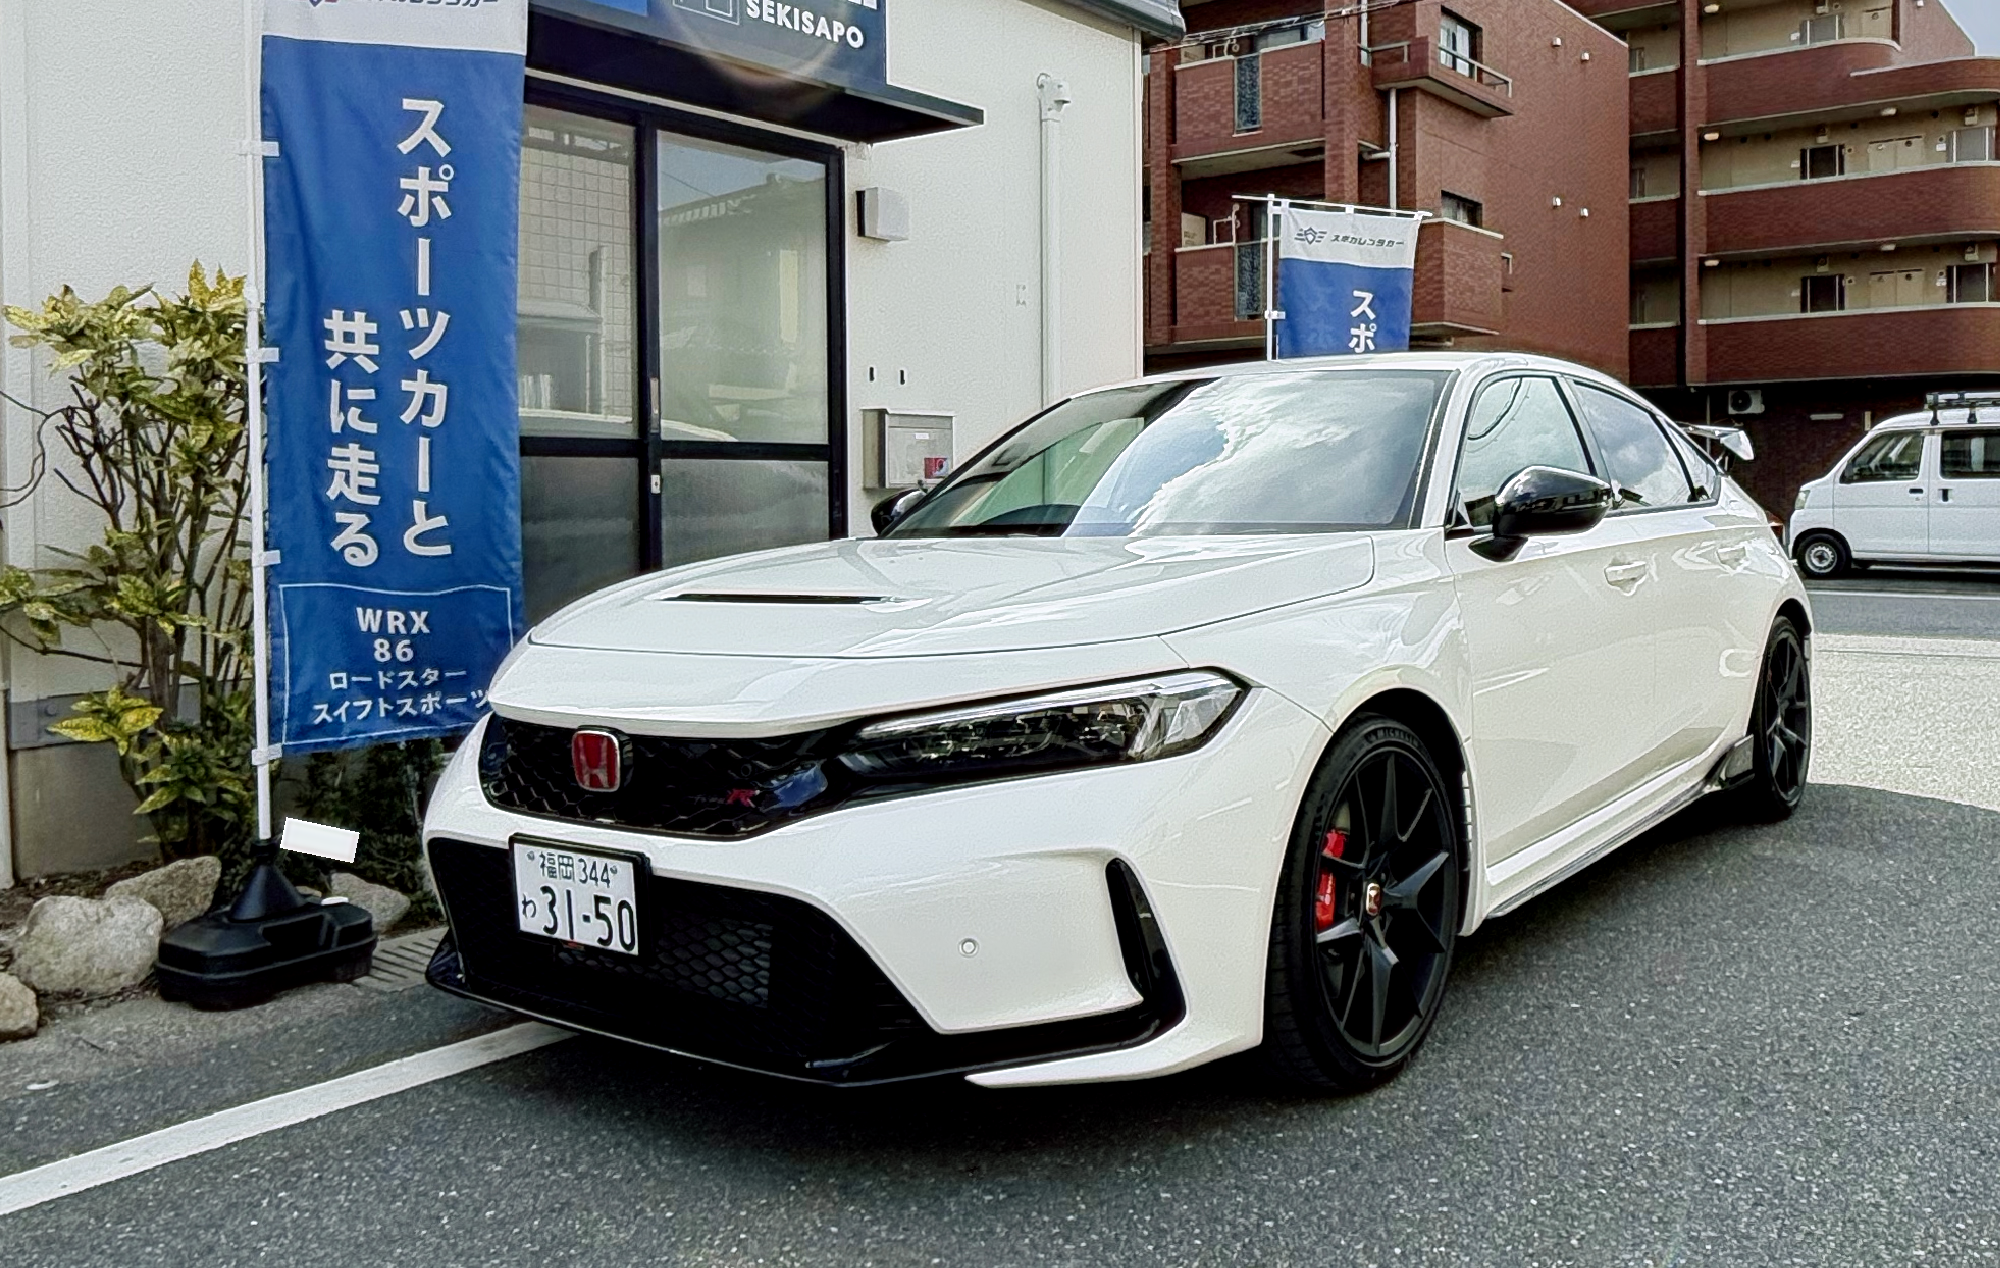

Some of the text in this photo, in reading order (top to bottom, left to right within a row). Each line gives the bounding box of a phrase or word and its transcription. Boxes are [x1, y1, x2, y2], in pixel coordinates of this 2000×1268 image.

[746, 0, 865, 49] SEKISAPO
[397, 97, 455, 557] スポーツカーと
[1348, 289, 1377, 354] スポ
[323, 309, 381, 568] 共に走る
[356, 607, 431, 635] WRX
[373, 638, 414, 663] 86
[329, 668, 467, 690] ロードスター
[313, 690, 488, 725] スイフトスポーツ
[539, 851, 611, 888] 福岡 344
[521, 885, 636, 952] わ 31-50
